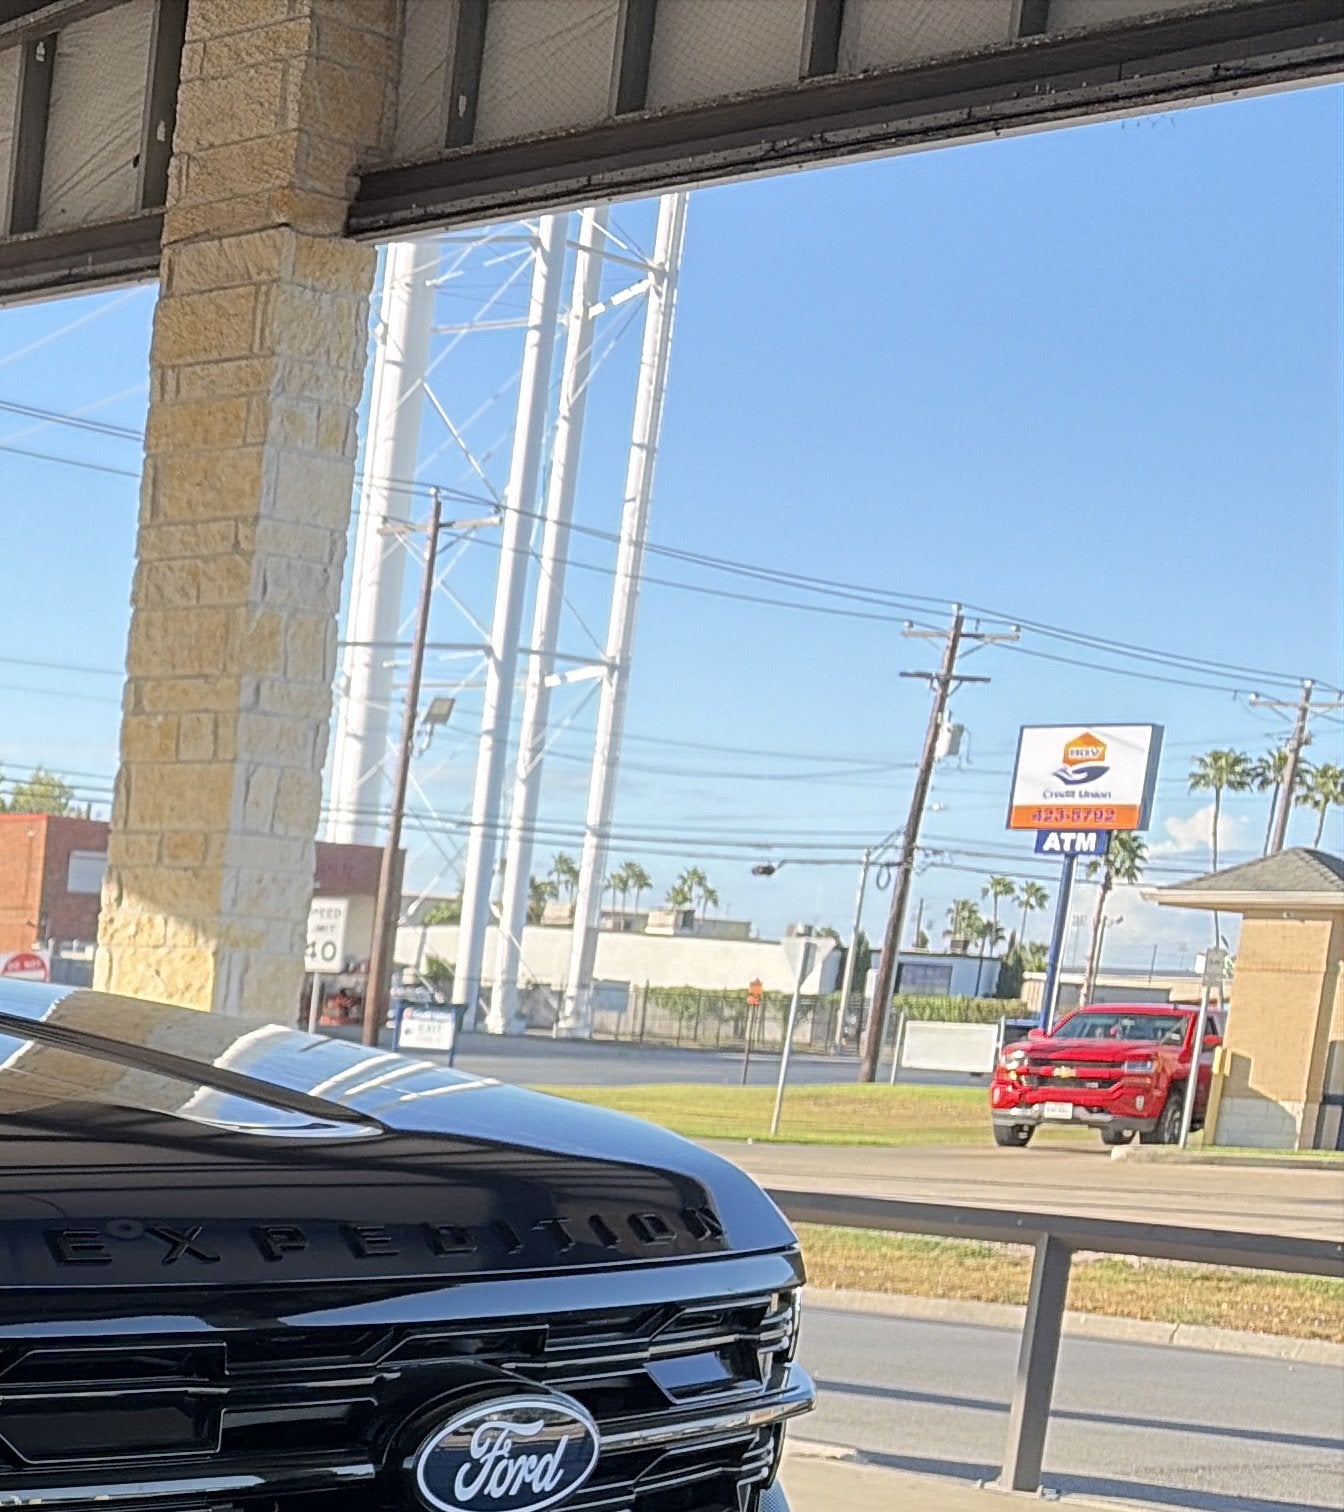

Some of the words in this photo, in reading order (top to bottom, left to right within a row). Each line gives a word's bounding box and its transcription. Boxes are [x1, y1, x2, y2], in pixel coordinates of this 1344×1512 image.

[1043, 832, 1097, 852] ATM
[304, 941, 337, 962] 40
[42, 1204, 725, 1267] EXPEDITION
[454, 1420, 570, 1502] Ford
